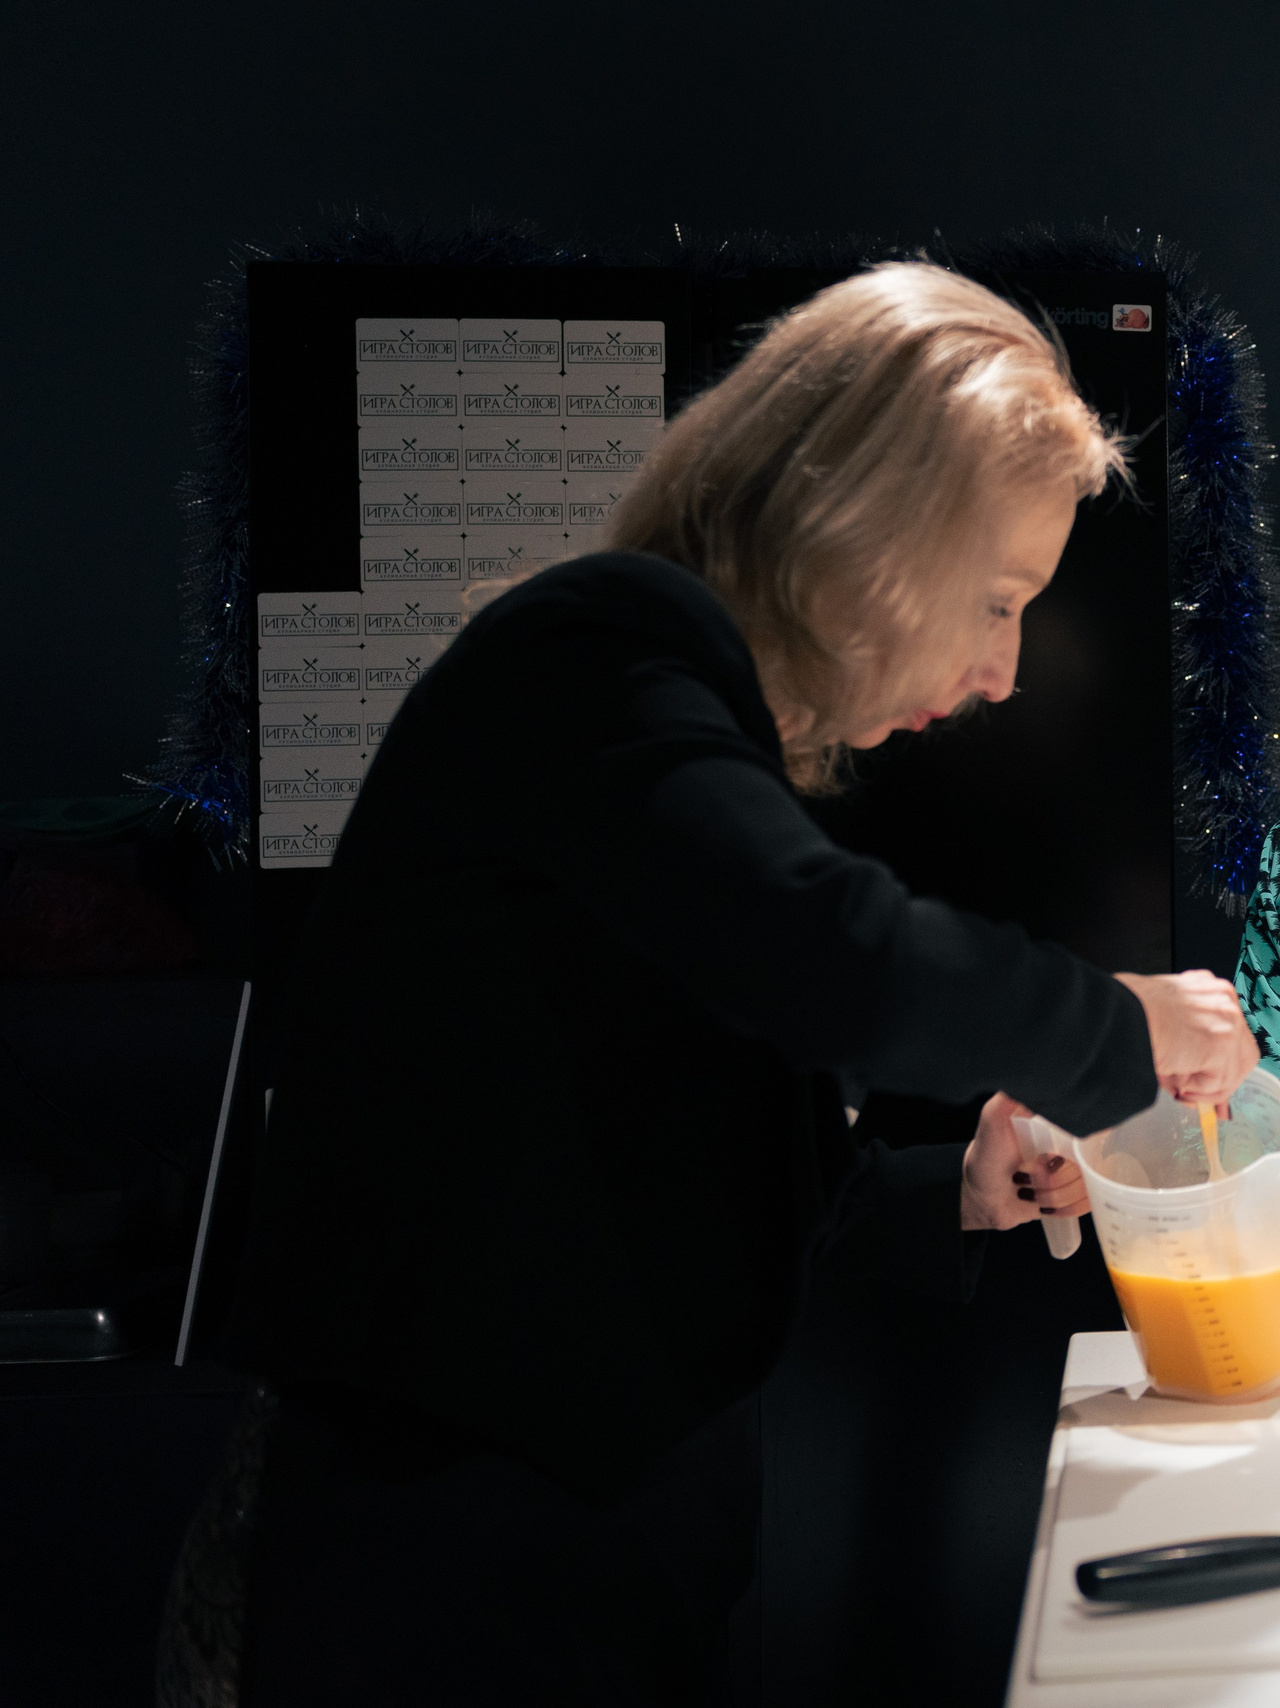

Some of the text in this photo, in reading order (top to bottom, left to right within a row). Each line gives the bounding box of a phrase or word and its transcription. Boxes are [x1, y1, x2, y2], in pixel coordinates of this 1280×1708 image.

[363, 343, 453, 354] ИГРА СТОЛОВ
[466, 343, 556, 354] ИГРА СТОЛОВ
[570, 345, 660, 356] ИГРА СТОЛОВ
[364, 397, 454, 408] ИГРА СТОЛОВ
[467, 397, 557, 409] ИГРА СТОЛОВ
[569, 398, 659, 409] ИГРА СТОЛОВ
[365, 452, 455, 463] ИГРА СТОЛОВ
[469, 452, 559, 463] ИГРА СТОЛОВ
[570, 453, 645, 464] ИГРА СТОЛ
[367, 506, 457, 518] ИГРА СТОЛОВ
[470, 506, 560, 517] ИГРА СТОЛОВ
[573, 506, 604, 517] ИГРА
[367, 562, 457, 573] ИГРА СТОЛОВ
[472, 561, 504, 572] ИГРА
[265, 617, 355, 628] ИГРА СТОЛОВ
[368, 616, 458, 628] ИГРА СТОЛОВ
[266, 672, 356, 683] ИГРА СТОЛОВ
[369, 672, 402, 682] ИГРА
[266, 727, 356, 739] ИГРА СТОЛОВ
[268, 782, 357, 794] ИГРА СТОЛОВ
[266, 838, 338, 850] ИГРА СТОЛ
